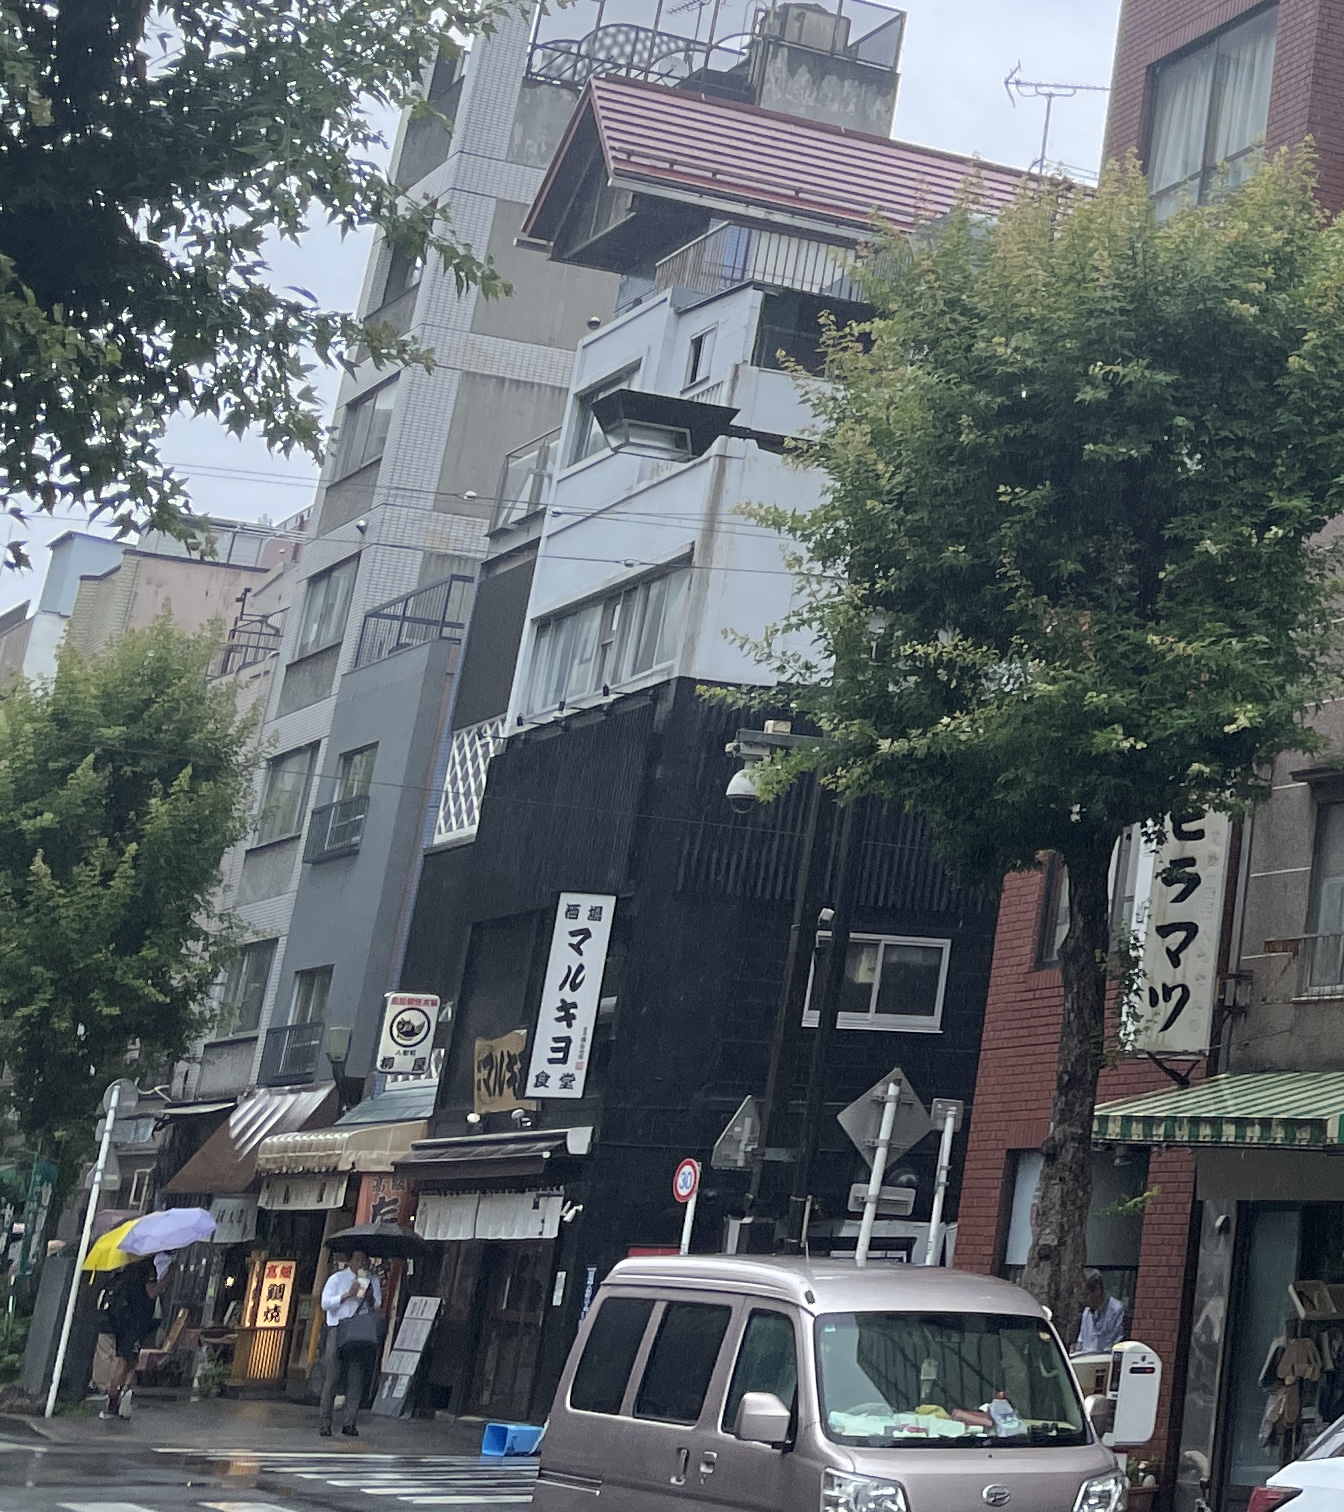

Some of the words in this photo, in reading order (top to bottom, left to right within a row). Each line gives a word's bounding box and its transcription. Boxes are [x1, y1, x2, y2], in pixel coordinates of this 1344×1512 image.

[547, 927, 593, 1066] マルキヨ
[533, 1071, 576, 1090] 食堂
[678, 1171, 693, 1190] 30
